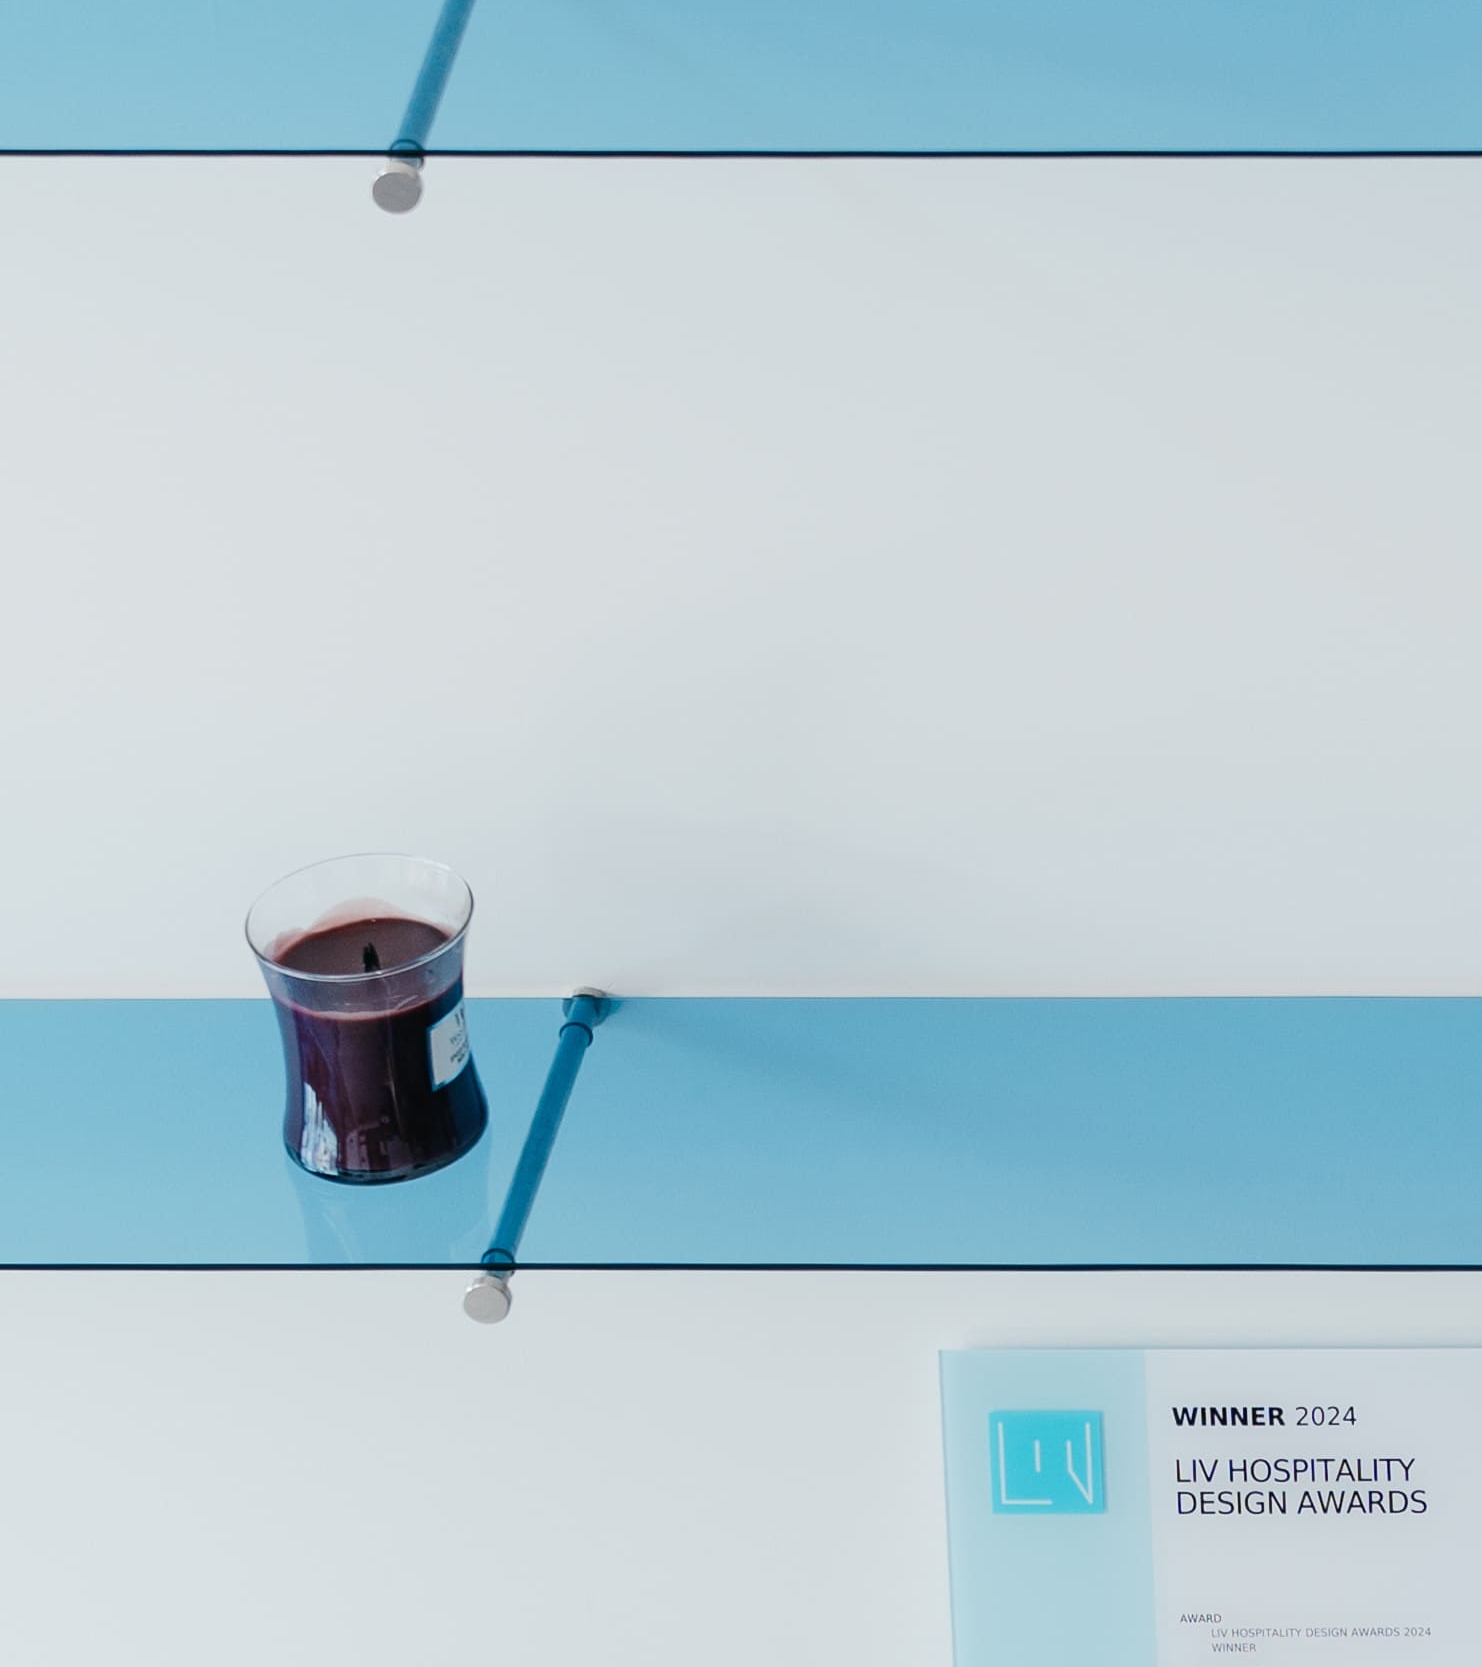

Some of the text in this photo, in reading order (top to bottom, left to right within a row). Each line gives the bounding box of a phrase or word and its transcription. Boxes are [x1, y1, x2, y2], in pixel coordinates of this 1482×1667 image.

[1172, 1405, 1357, 1427] WINNER 2024
[1175, 1458, 1416, 1483] LIV HOSPITALITY
[1177, 1489, 1428, 1515] DESIGN AWARDS
[1179, 1613, 1222, 1624] AWARD
[1210, 1626, 1432, 1639] LIV HOSPITALITY DESIGN AWARDS 2024
[1211, 1642, 1257, 1653] WINNER
